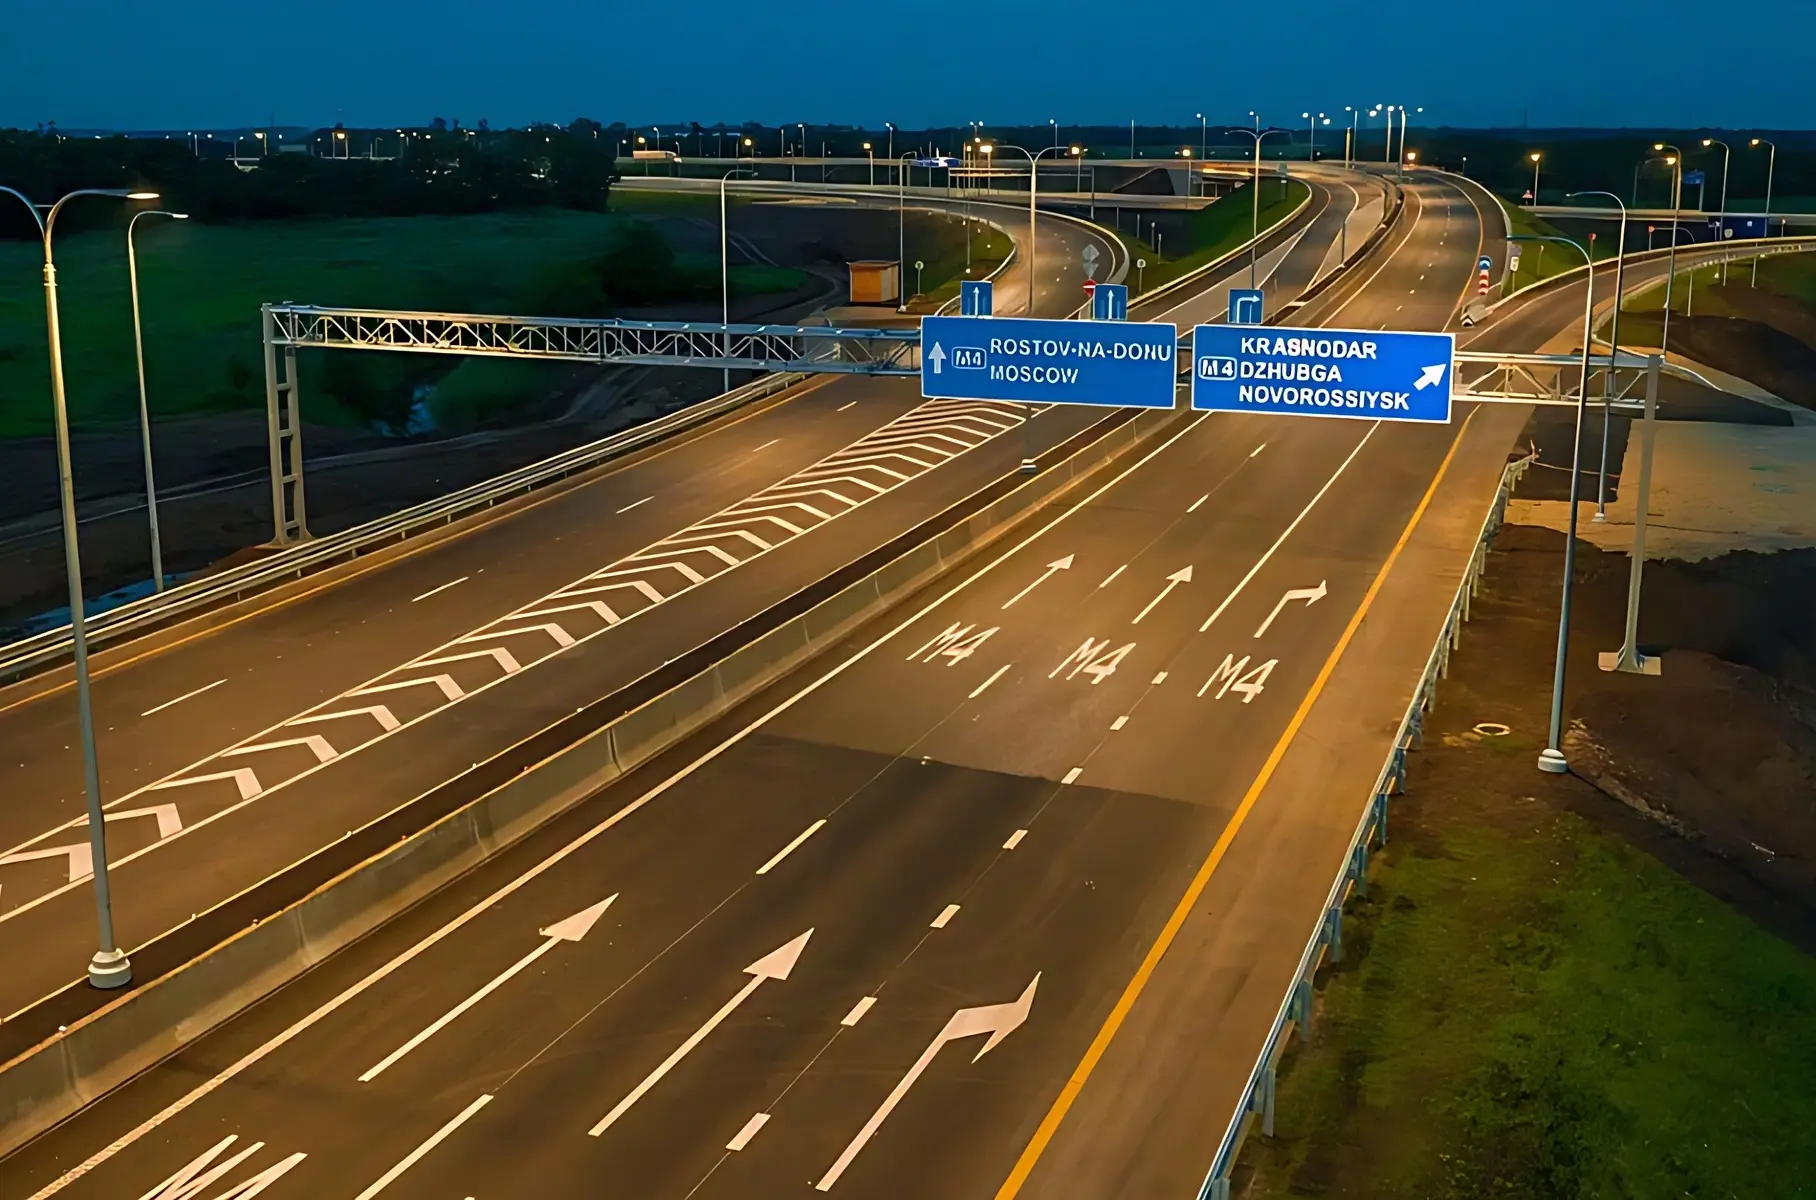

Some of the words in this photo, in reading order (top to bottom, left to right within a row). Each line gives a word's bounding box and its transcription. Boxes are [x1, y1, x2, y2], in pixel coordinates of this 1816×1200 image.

[990, 338, 1171, 361] ROSTOV-NA-DONU
[1241, 337, 1377, 359] KRASNODAR
[990, 365, 1078, 384] MOSCOW
[1202, 359, 1234, 376] M4
[1240, 361, 1342, 382] DZHUBGA
[1239, 385, 1410, 410] NOVOROSSIYSK
[906, 622, 1000, 667] M4
[1048, 637, 1136, 685] M4
[1196, 653, 1279, 704] M4
